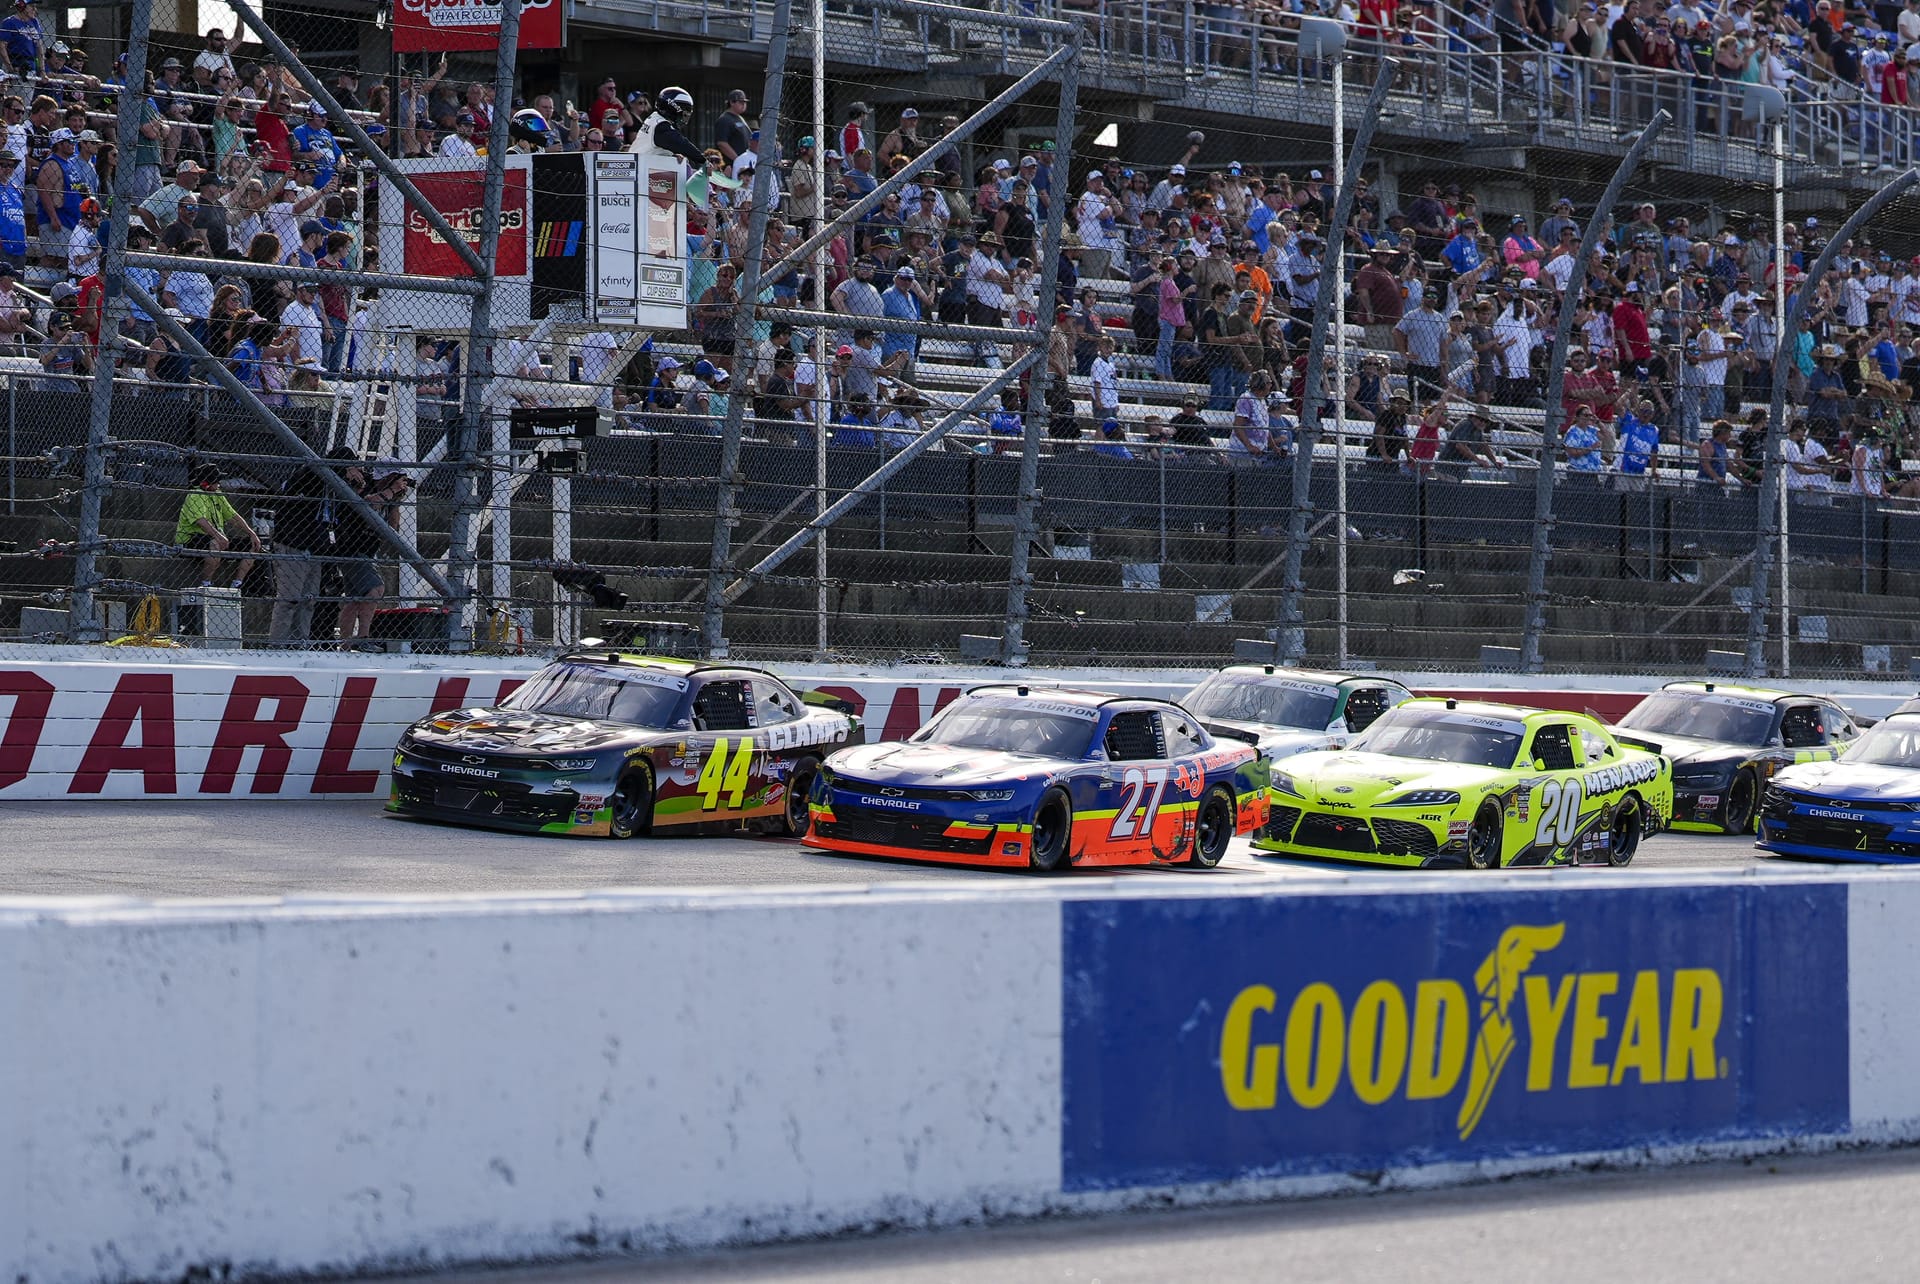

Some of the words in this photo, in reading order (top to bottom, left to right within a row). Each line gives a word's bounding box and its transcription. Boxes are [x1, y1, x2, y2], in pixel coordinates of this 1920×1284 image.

[601, 197, 630, 207] BUSCH
[600, 275, 632, 288] xfinity
[655, 269, 677, 283] NASCAR
[647, 286, 658, 296] CUP
[658, 287, 677, 298] SERIES
[532, 424, 576, 435] WHELEN
[627, 672, 667, 684] POOLE
[1281, 680, 1326, 693] BILICKI
[1740, 700, 1763, 709] SIEG
[1467, 717, 1504, 728] JONES
[440, 764, 500, 779] CHEVROLET
[697, 737, 754, 810] 44
[1583, 760, 1658, 798] MENARDS
[861, 796, 921, 810] CHEVROLET
[1107, 766, 1170, 840] 27
[1316, 797, 1357, 812] Supra
[1416, 813, 1442, 822] JGR
[1535, 778, 1581, 847] 20
[1809, 808, 1865, 821] CHEVROLET
[1220, 968, 1723, 1111] GOODYEAR
